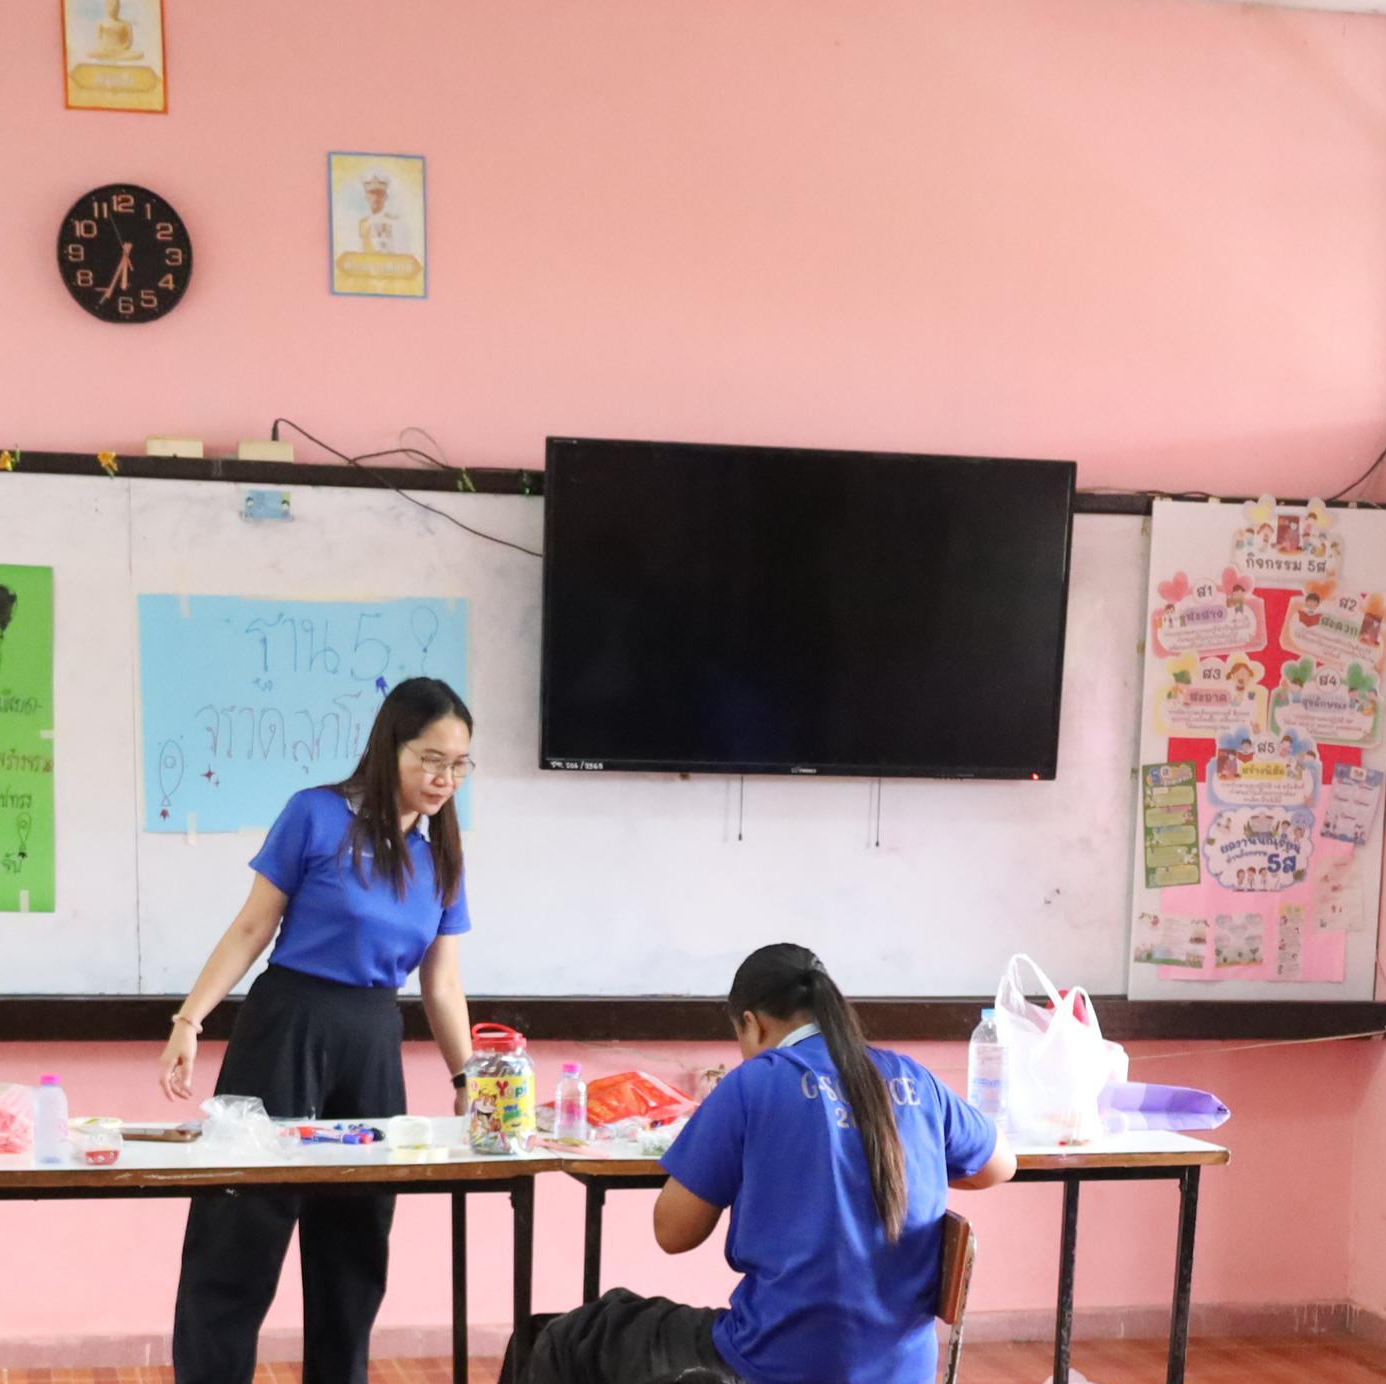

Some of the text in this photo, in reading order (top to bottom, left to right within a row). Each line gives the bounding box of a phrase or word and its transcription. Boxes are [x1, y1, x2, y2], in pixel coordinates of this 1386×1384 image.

[93, 201, 108, 219] 11
[112, 194, 135, 213] 12
[145, 202, 152, 220] 1
[74, 219, 98, 238] 10
[156, 222, 174, 240] 2
[68, 243, 85, 262] 9
[165, 247, 183, 266] 3
[76, 269, 94, 287] 8
[157, 273, 175, 290] 4
[118, 296, 134, 314] 6
[140, 289, 158, 308] 5
[1245, 551, 1302, 571] กิจกรรม
[1267, 853, 1297, 874] 5ส
